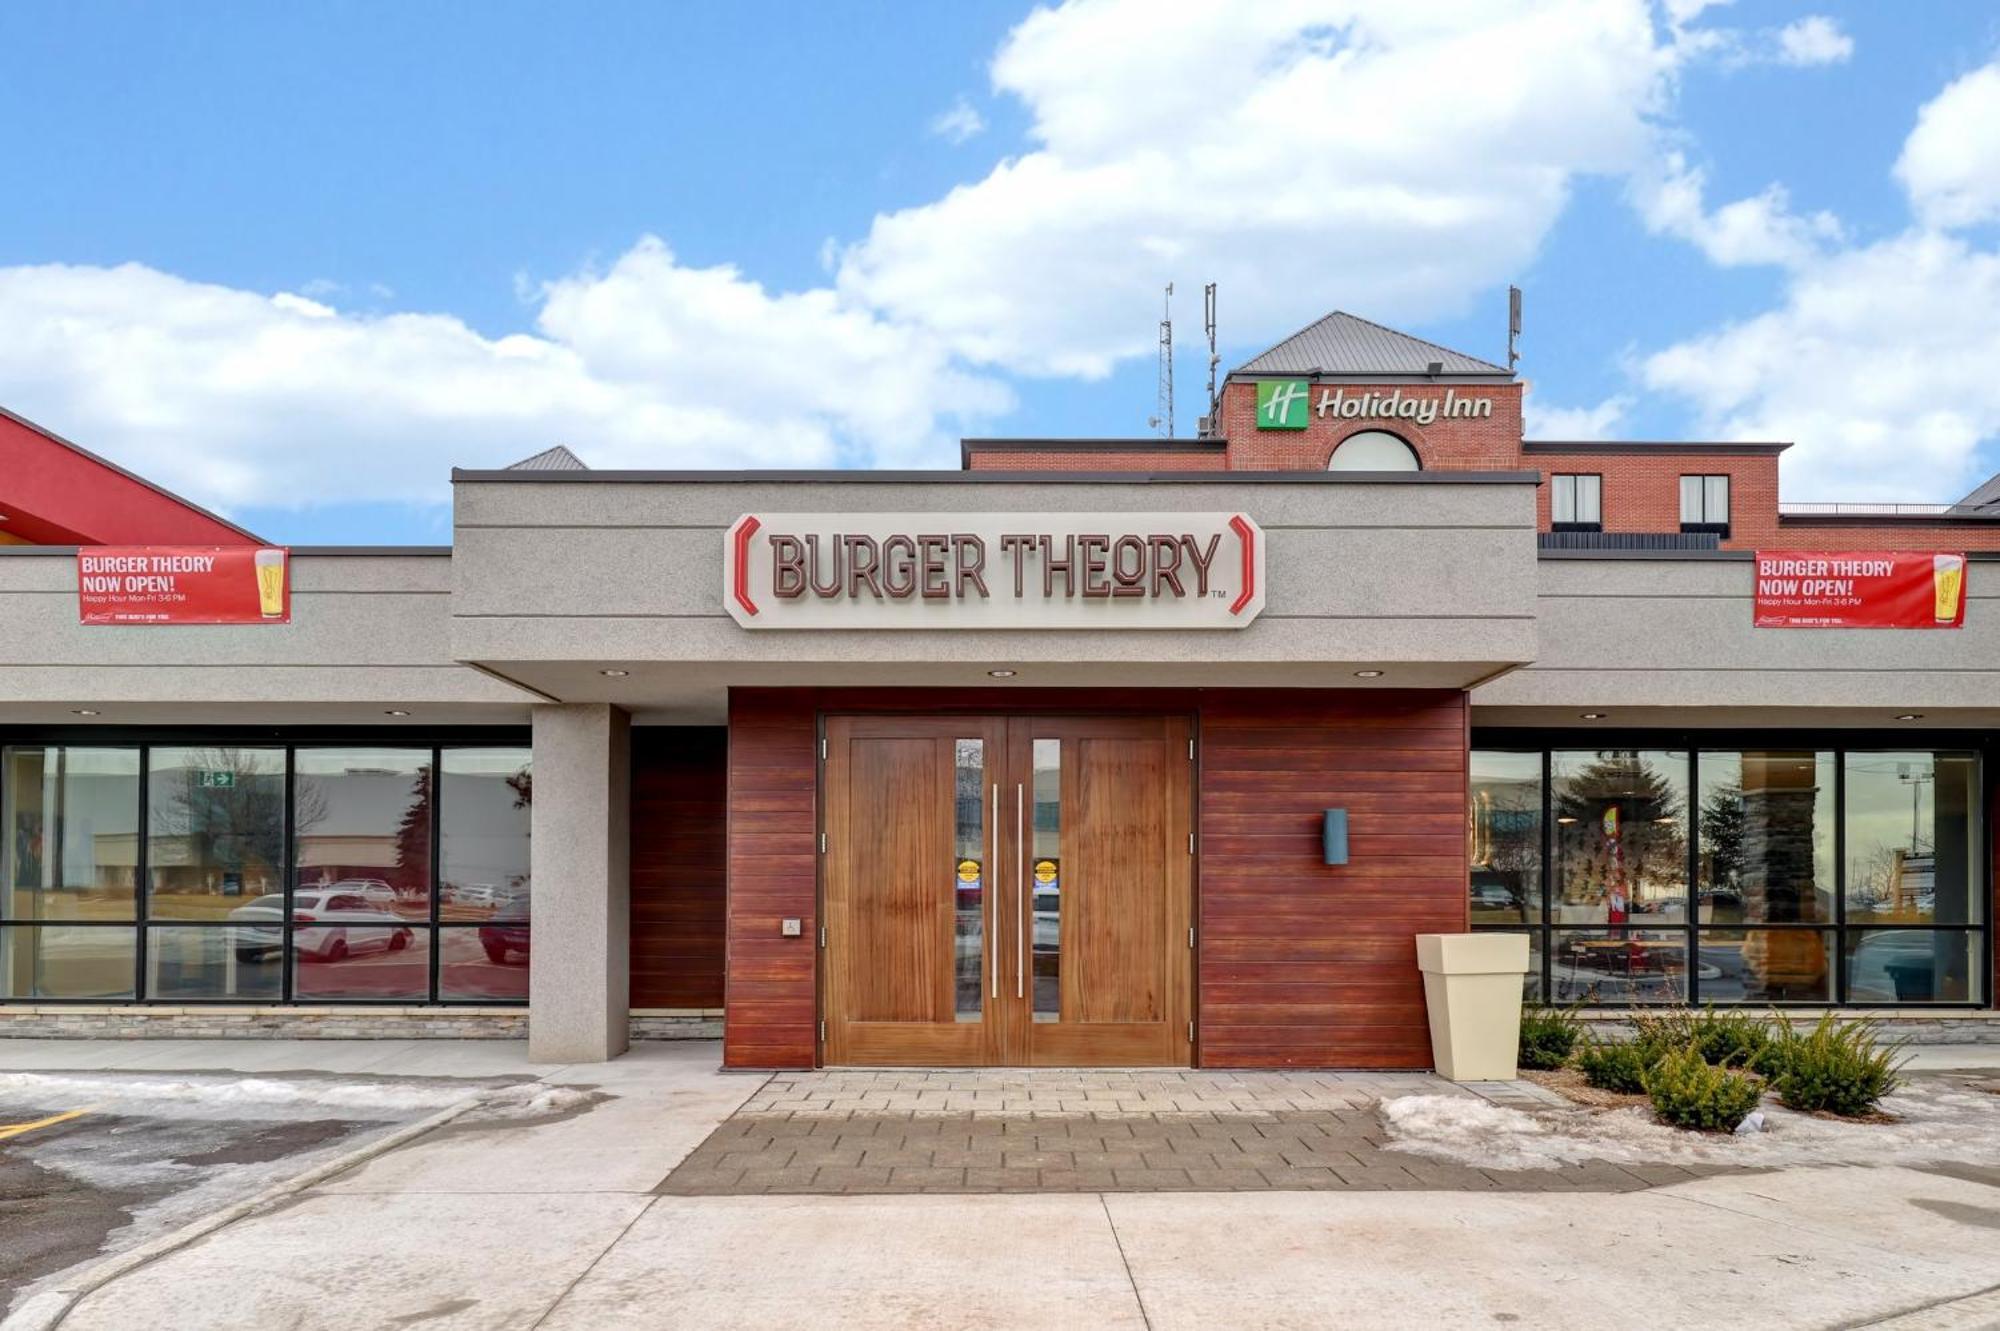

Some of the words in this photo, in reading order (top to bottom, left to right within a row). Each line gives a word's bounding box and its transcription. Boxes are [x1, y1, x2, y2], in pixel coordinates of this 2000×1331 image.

[1316, 389, 1438, 424] Holiday
[1444, 389, 1492, 417] Inn
[82, 556, 148, 573] BURGER
[150, 556, 214, 573] THEORY
[769, 534, 989, 598] BURGER
[1000, 534, 1222, 598] THEORY
[1759, 560, 1828, 576] BURGER
[1831, 560, 1894, 577] THEORY
[83, 576, 121, 593] NOW
[125, 576, 175, 592] OPEN!
[1759, 580, 1799, 596] NOW
[1802, 579, 1853, 596] OPEN!
[82, 594, 107, 603] Happy
[109, 594, 127, 602] Hour
[129, 594, 156, 602] Mon-Fri
[173, 594, 186, 602] PM
[1758, 598, 1781, 606] Happy
[1848, 598, 1862, 606] PM
